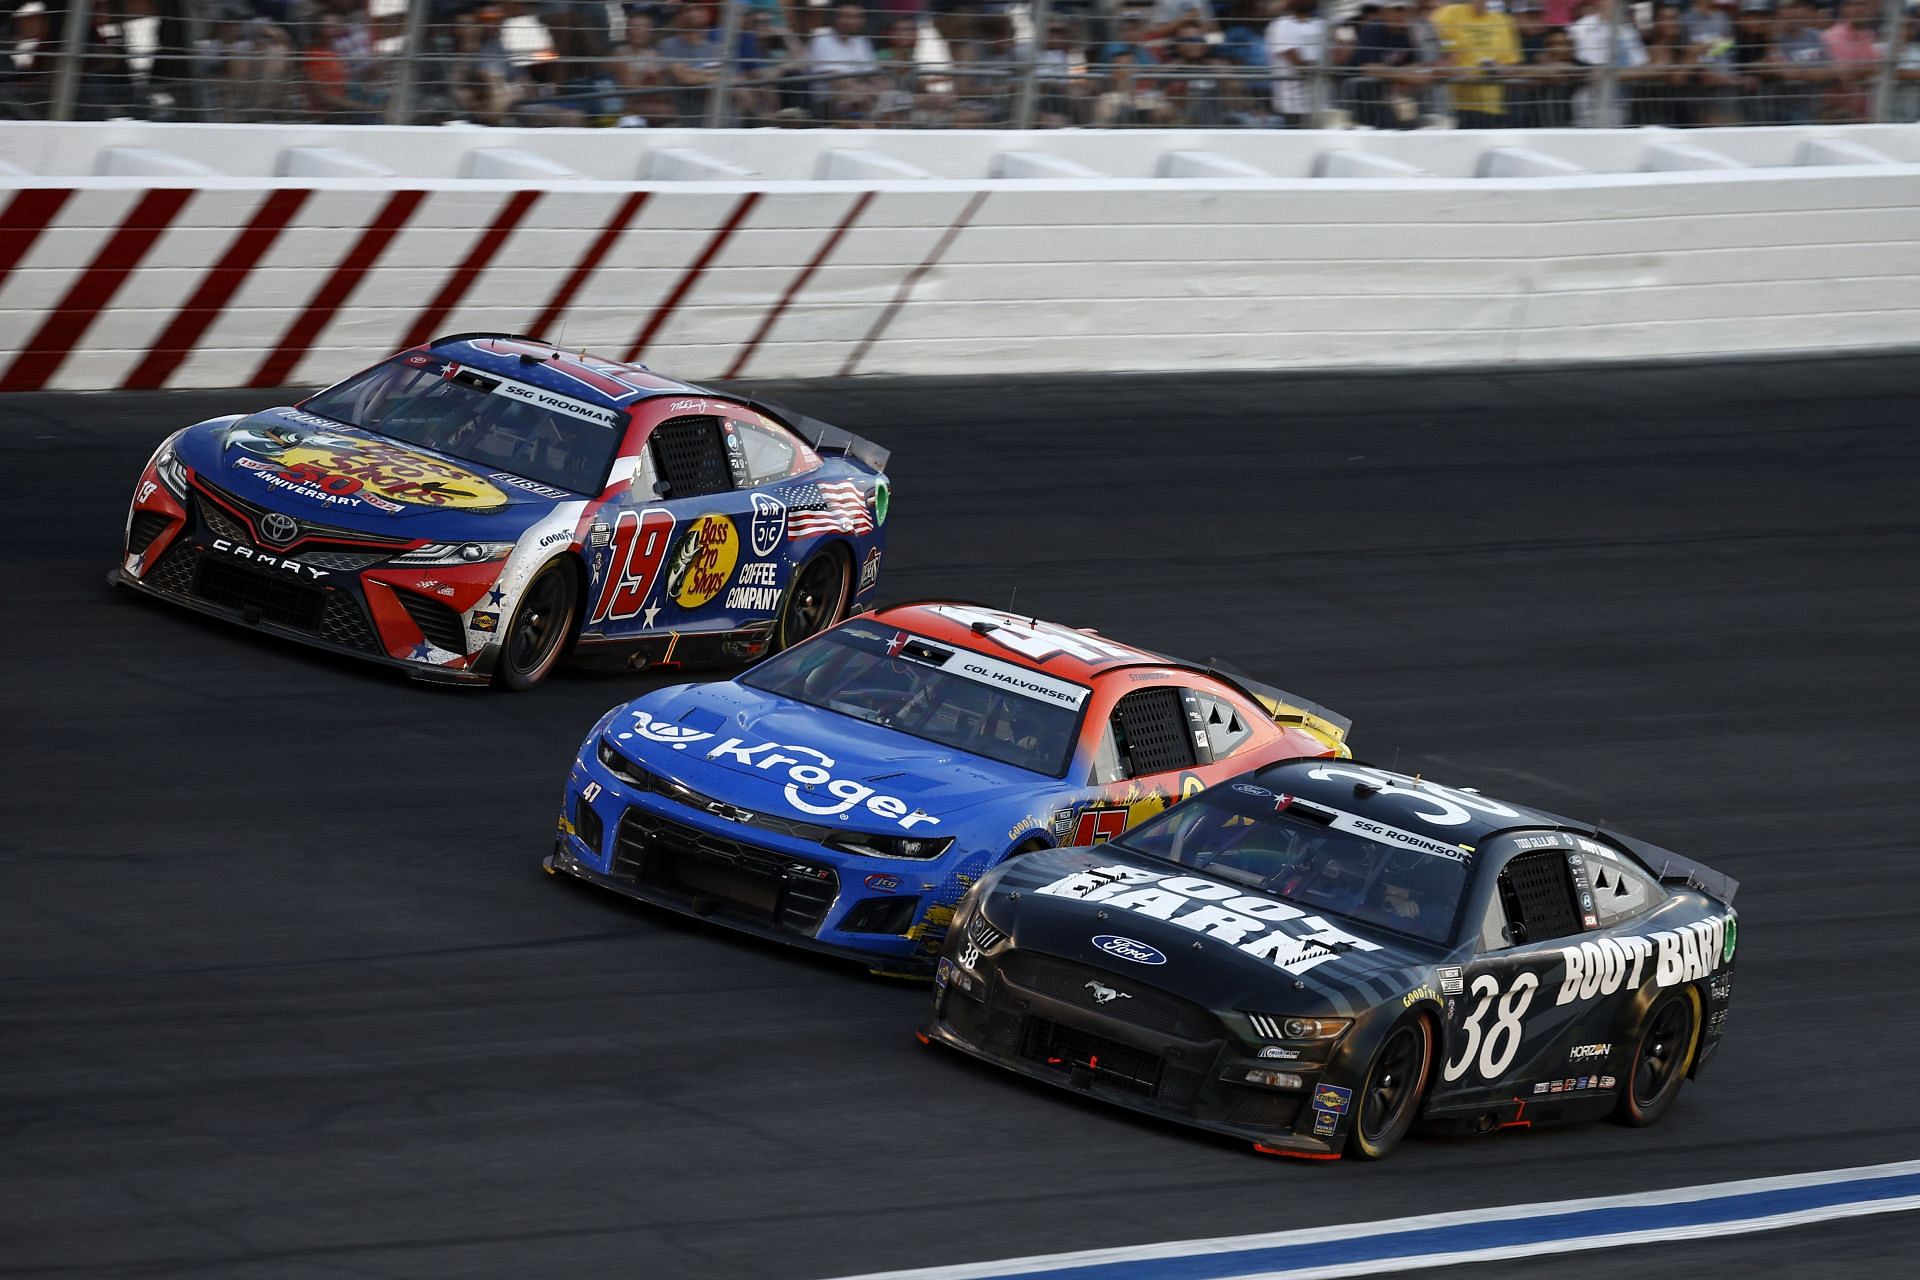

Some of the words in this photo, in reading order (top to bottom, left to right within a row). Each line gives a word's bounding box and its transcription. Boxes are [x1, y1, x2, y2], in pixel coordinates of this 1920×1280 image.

[505, 385, 535, 399] SSG
[538, 394, 617, 427] VROOMAN
[253, 470, 362, 508] ANNIVERSARY
[278, 462, 364, 497] 50
[303, 480, 323, 490] TH
[699, 517, 729, 545] Bass
[212, 539, 331, 579] CAMRY
[588, 508, 677, 625] 19
[694, 544, 719, 571] Pro
[738, 562, 778, 586] COFFEE
[687, 568, 725, 601] Shops
[725, 586, 783, 611] COMPANY
[963, 663, 989, 677] COL
[991, 672, 1077, 704] HALVORSEN
[582, 781, 602, 803] 47
[705, 737, 942, 831] Kroger
[1352, 820, 1384, 835] SSG
[1385, 830, 1468, 862] ROBINSON
[957, 942, 979, 970] 38
[1102, 938, 1155, 961] Ford
[1555, 935, 1653, 1006] BOOT
[1647, 915, 1724, 988] BARN
[1443, 972, 1540, 1082] 38
[1569, 1043, 1612, 1059] HORIZON
[1315, 1093, 1348, 1106] SUNOCO
